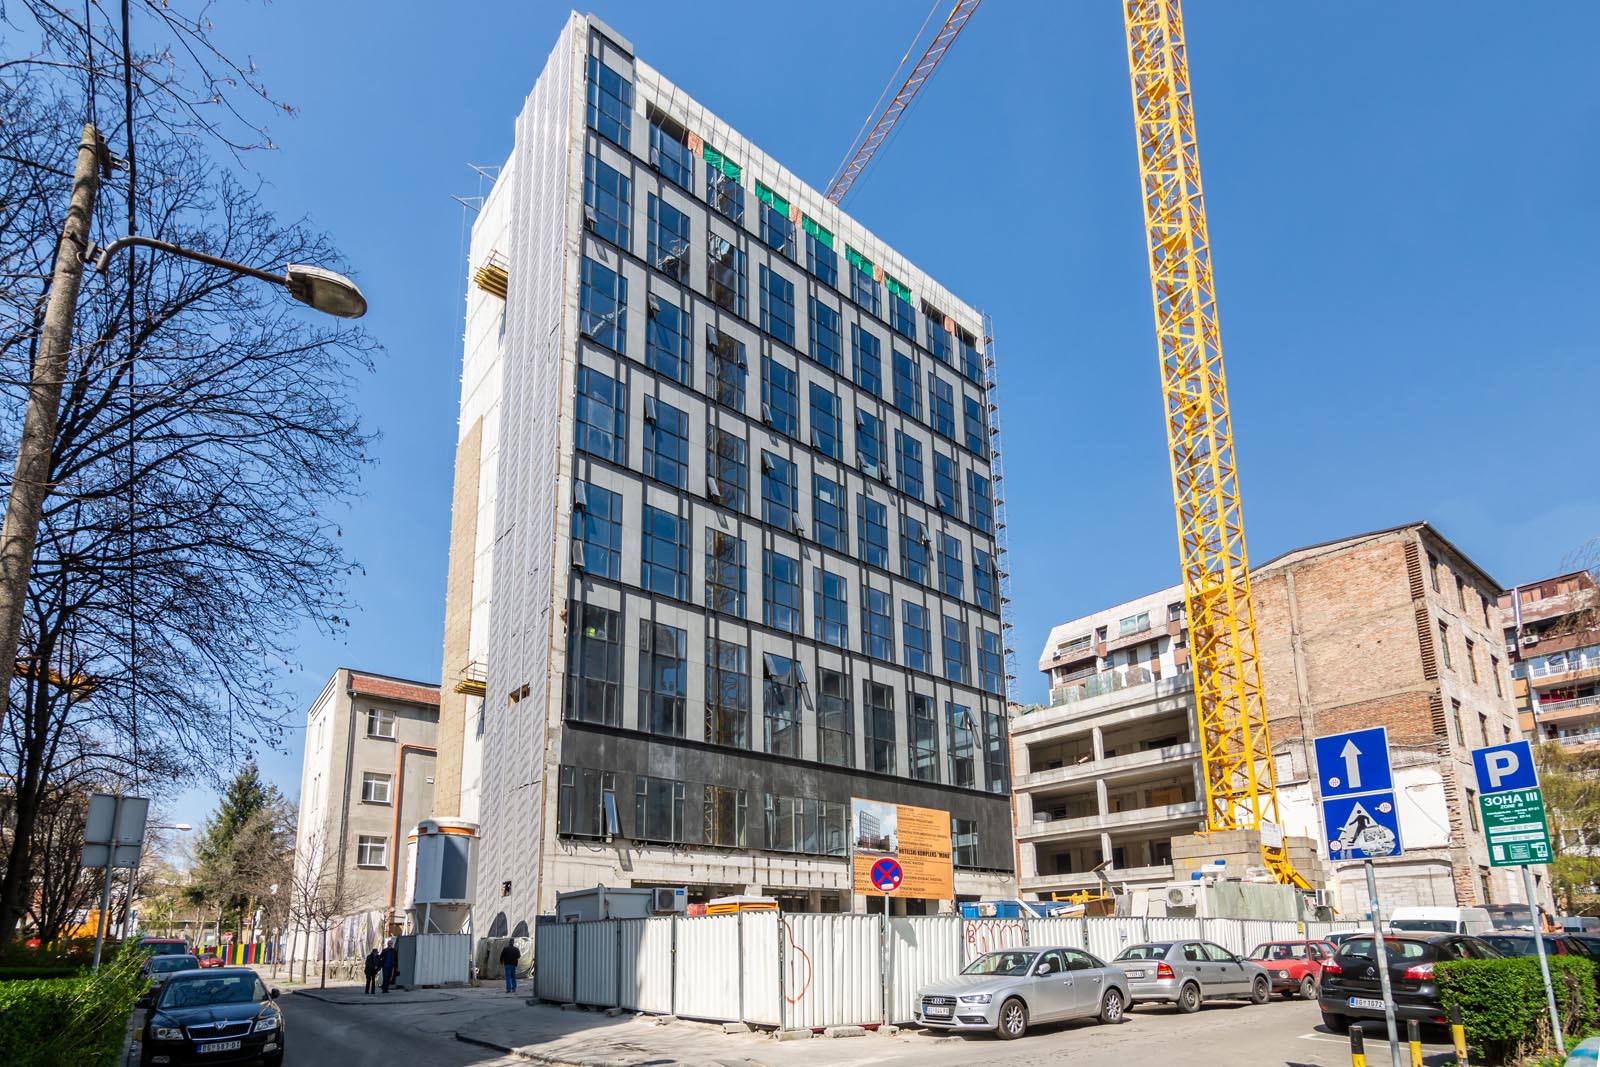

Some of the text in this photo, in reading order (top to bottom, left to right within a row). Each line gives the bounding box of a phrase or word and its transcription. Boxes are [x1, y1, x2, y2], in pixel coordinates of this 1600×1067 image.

[1484, 749, 1520, 788] P
[1484, 792, 1538, 807] ЗОНА III
